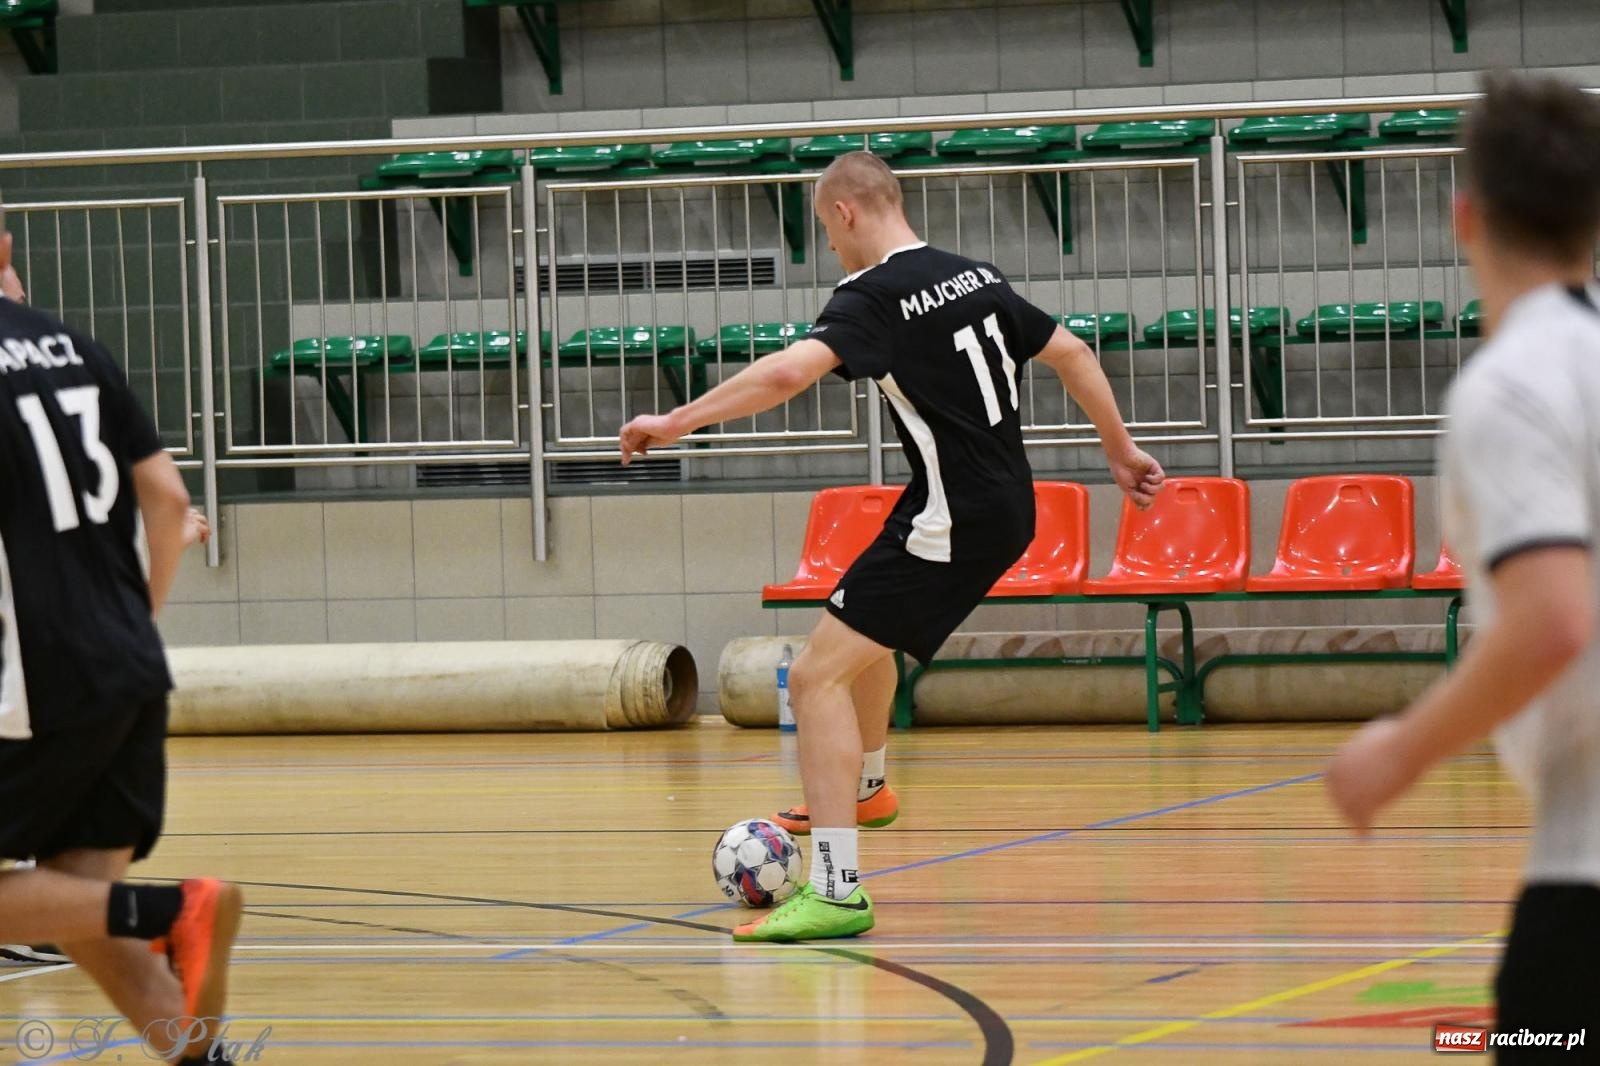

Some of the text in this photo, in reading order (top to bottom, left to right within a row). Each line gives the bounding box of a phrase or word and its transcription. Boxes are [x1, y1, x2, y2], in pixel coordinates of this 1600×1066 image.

[900, 271, 983, 320] MAJCHER
[953, 313, 1019, 427] 11
[16, 385, 119, 532] 13
